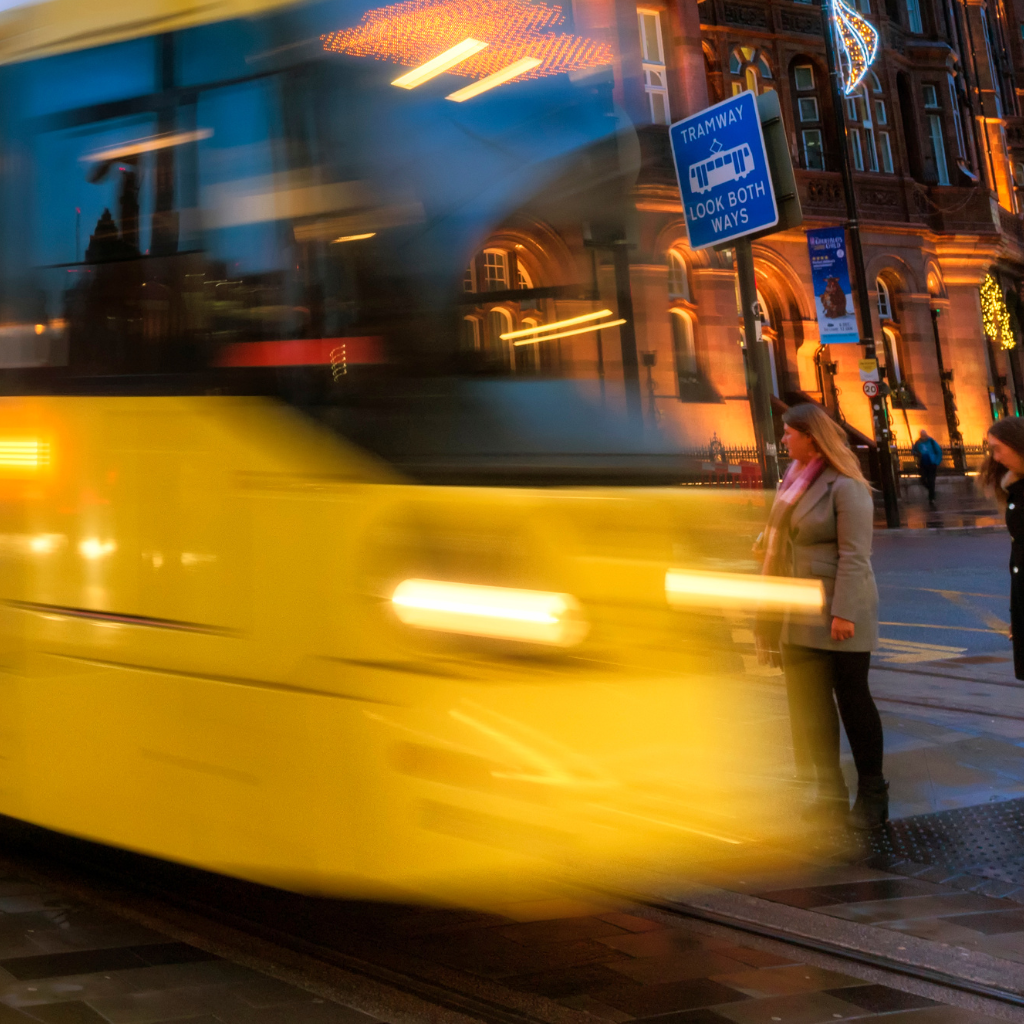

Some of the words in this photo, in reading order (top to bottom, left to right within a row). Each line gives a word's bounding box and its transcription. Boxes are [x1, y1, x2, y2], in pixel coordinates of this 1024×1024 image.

[680, 104, 744, 144] TRAMWAY
[689, 195, 725, 221] LOOK
[727, 180, 766, 208] BOTH
[711, 208, 749, 233] WAYS
